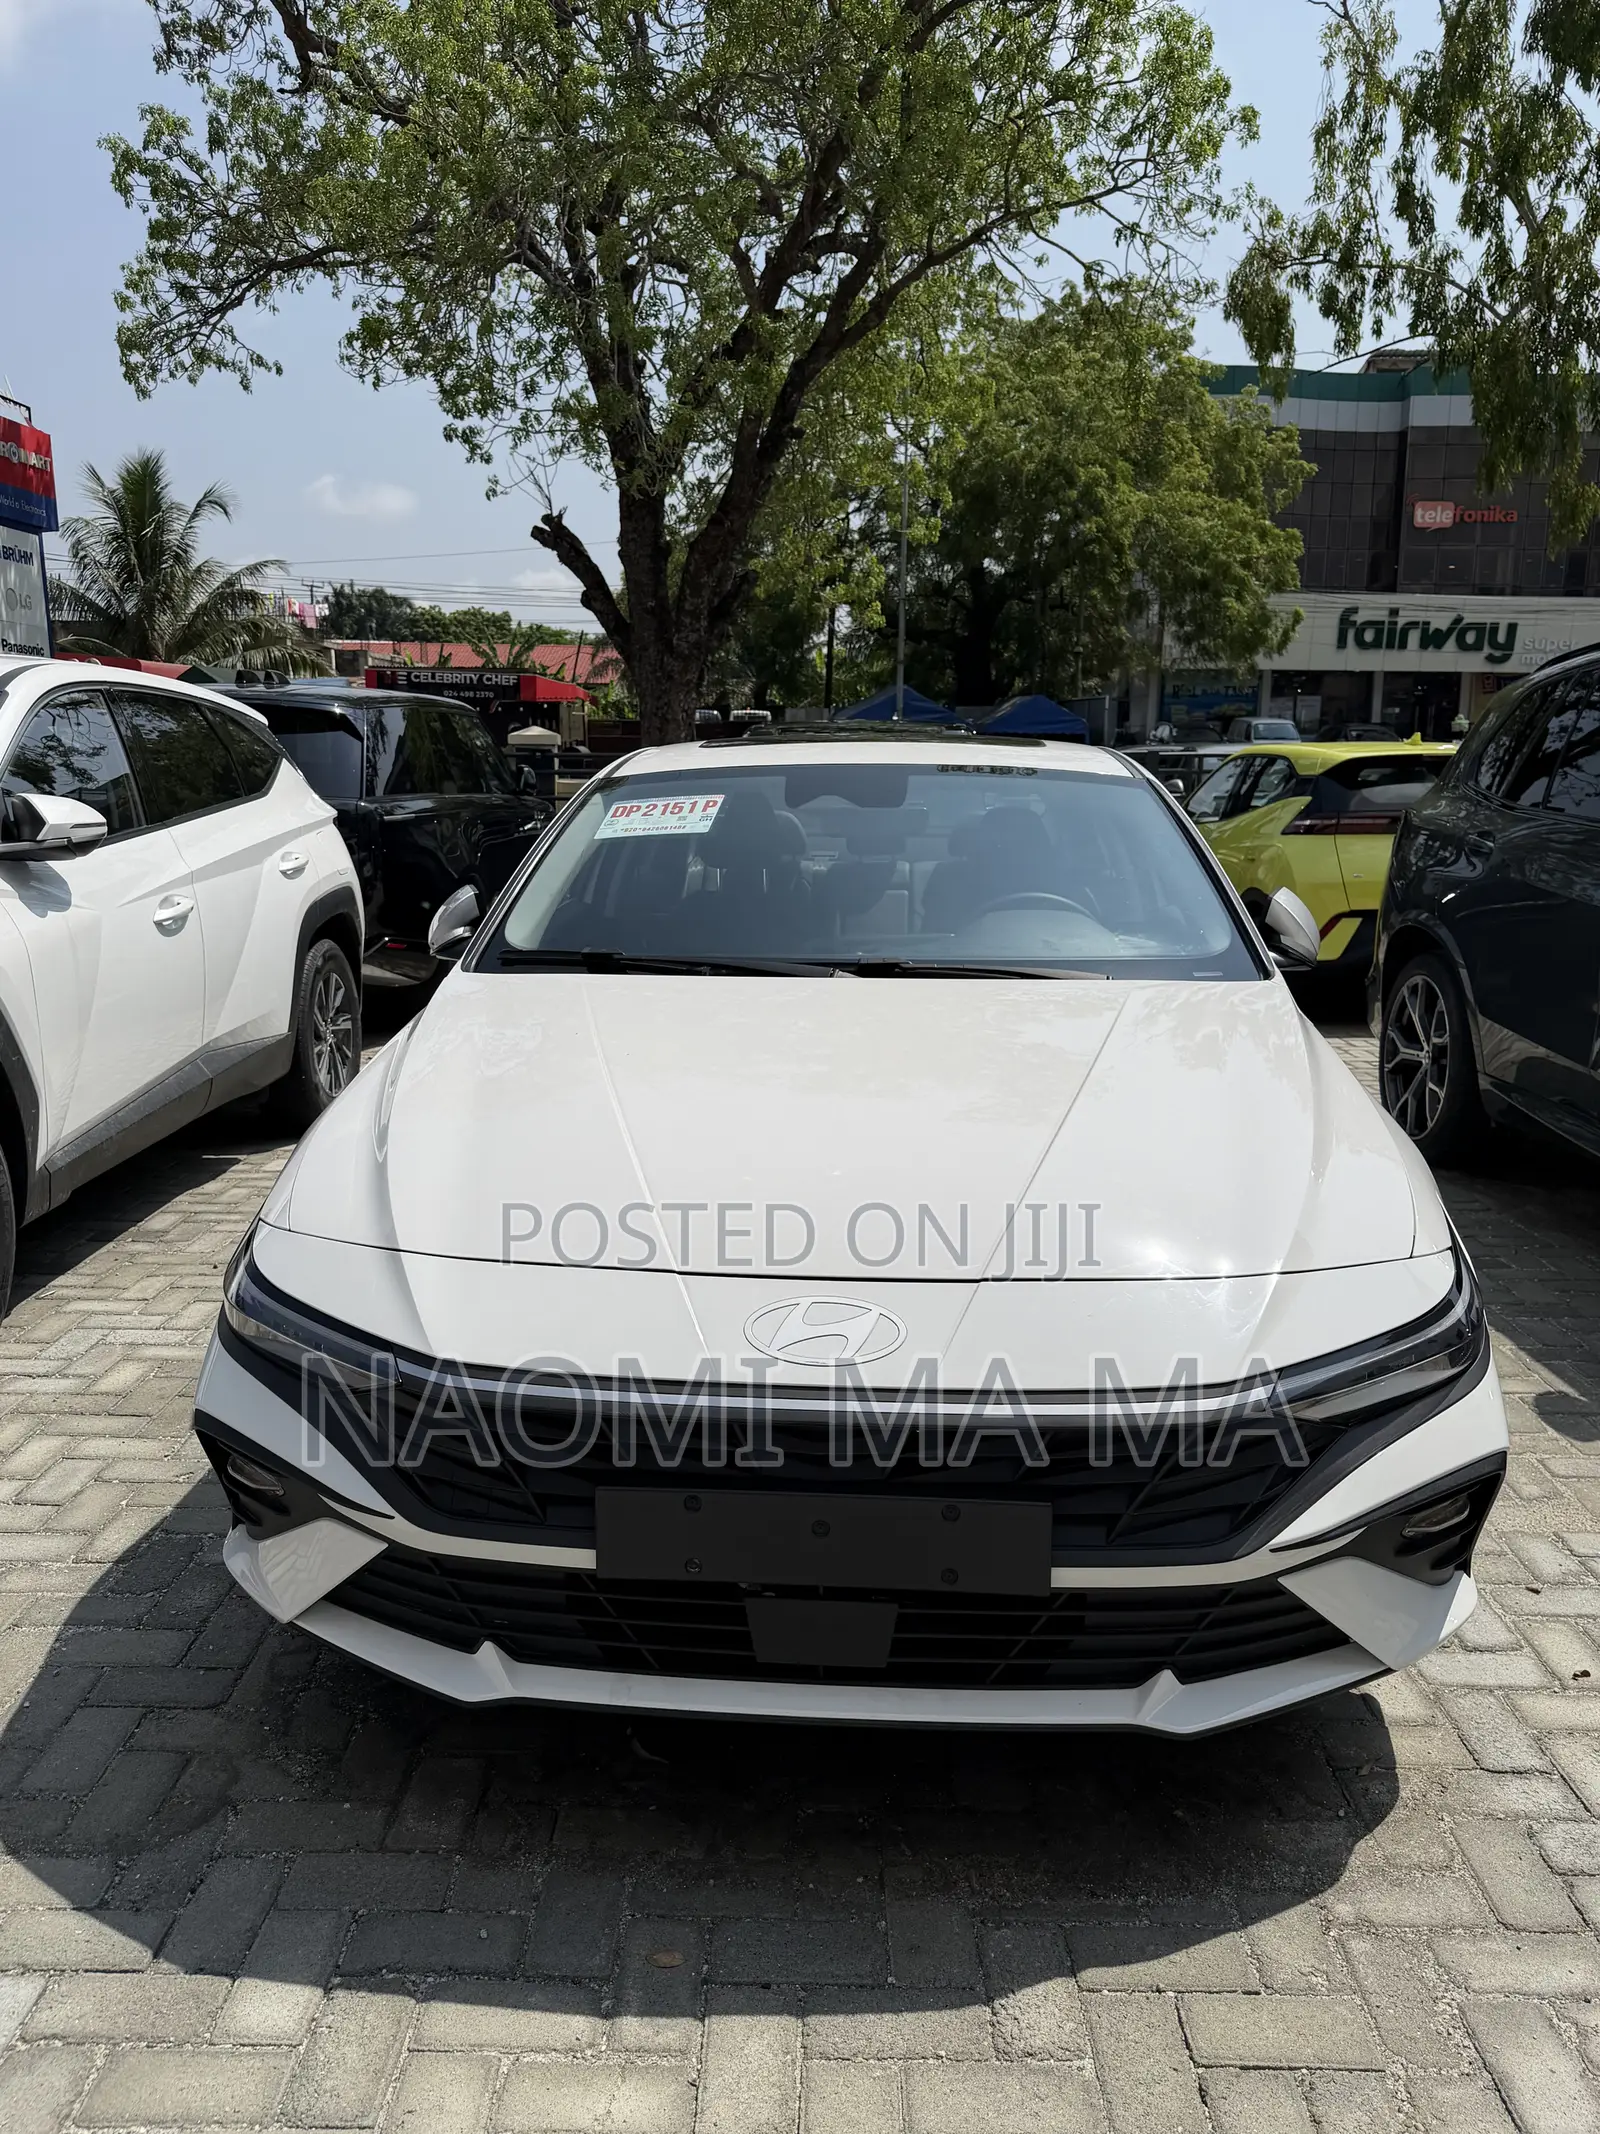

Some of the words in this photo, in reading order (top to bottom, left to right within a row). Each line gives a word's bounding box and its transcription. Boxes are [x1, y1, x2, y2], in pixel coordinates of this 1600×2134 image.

[1416, 505, 1518, 523] telefonika
[19, 592, 33, 611] LG
[1337, 606, 1518, 664] fairway
[1, 638, 45, 657] Panasonic
[1524, 637, 1577, 652] super
[410, 671, 479, 685] CELEBRITY
[482, 673, 518, 686] CHEF
